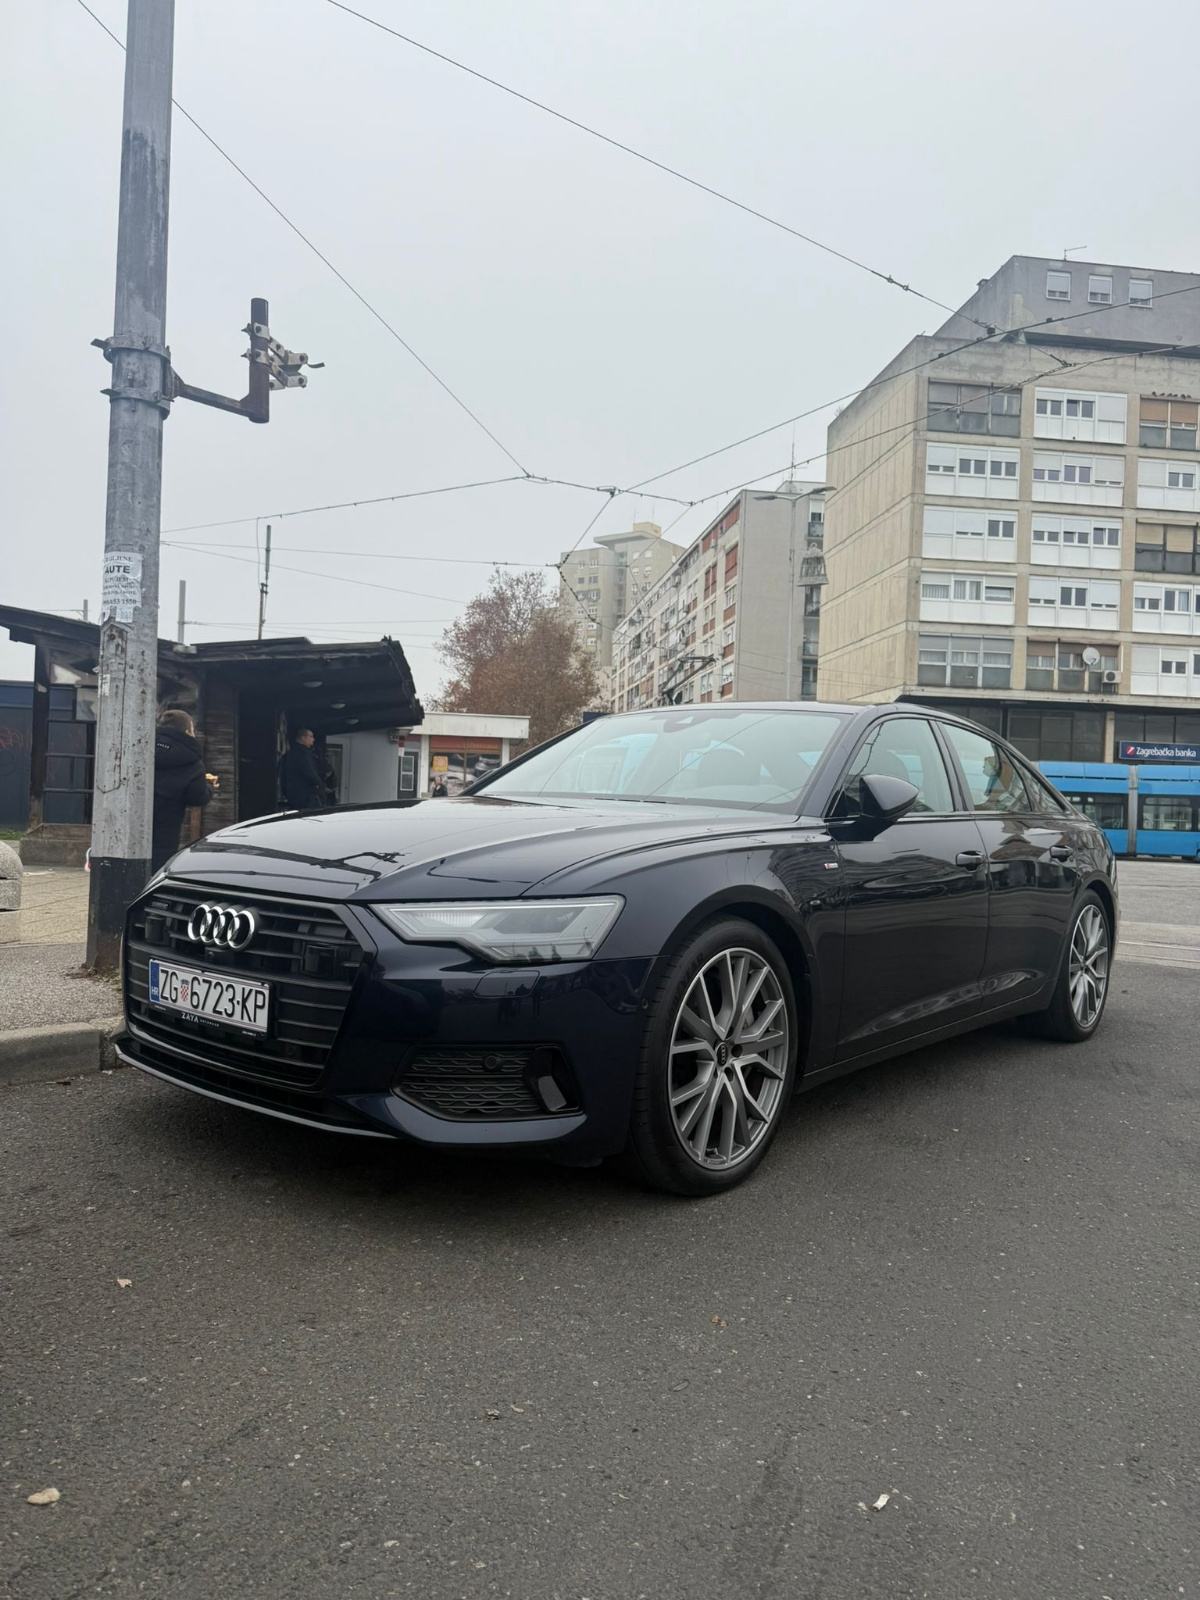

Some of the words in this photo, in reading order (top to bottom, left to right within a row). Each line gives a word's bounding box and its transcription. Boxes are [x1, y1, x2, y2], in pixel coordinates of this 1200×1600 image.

[1136, 746, 1174, 758] Zagrebačka
[1175, 747, 1197, 758] banka
[151, 986, 159, 997] HR
[160, 968, 179, 1004] ZG
